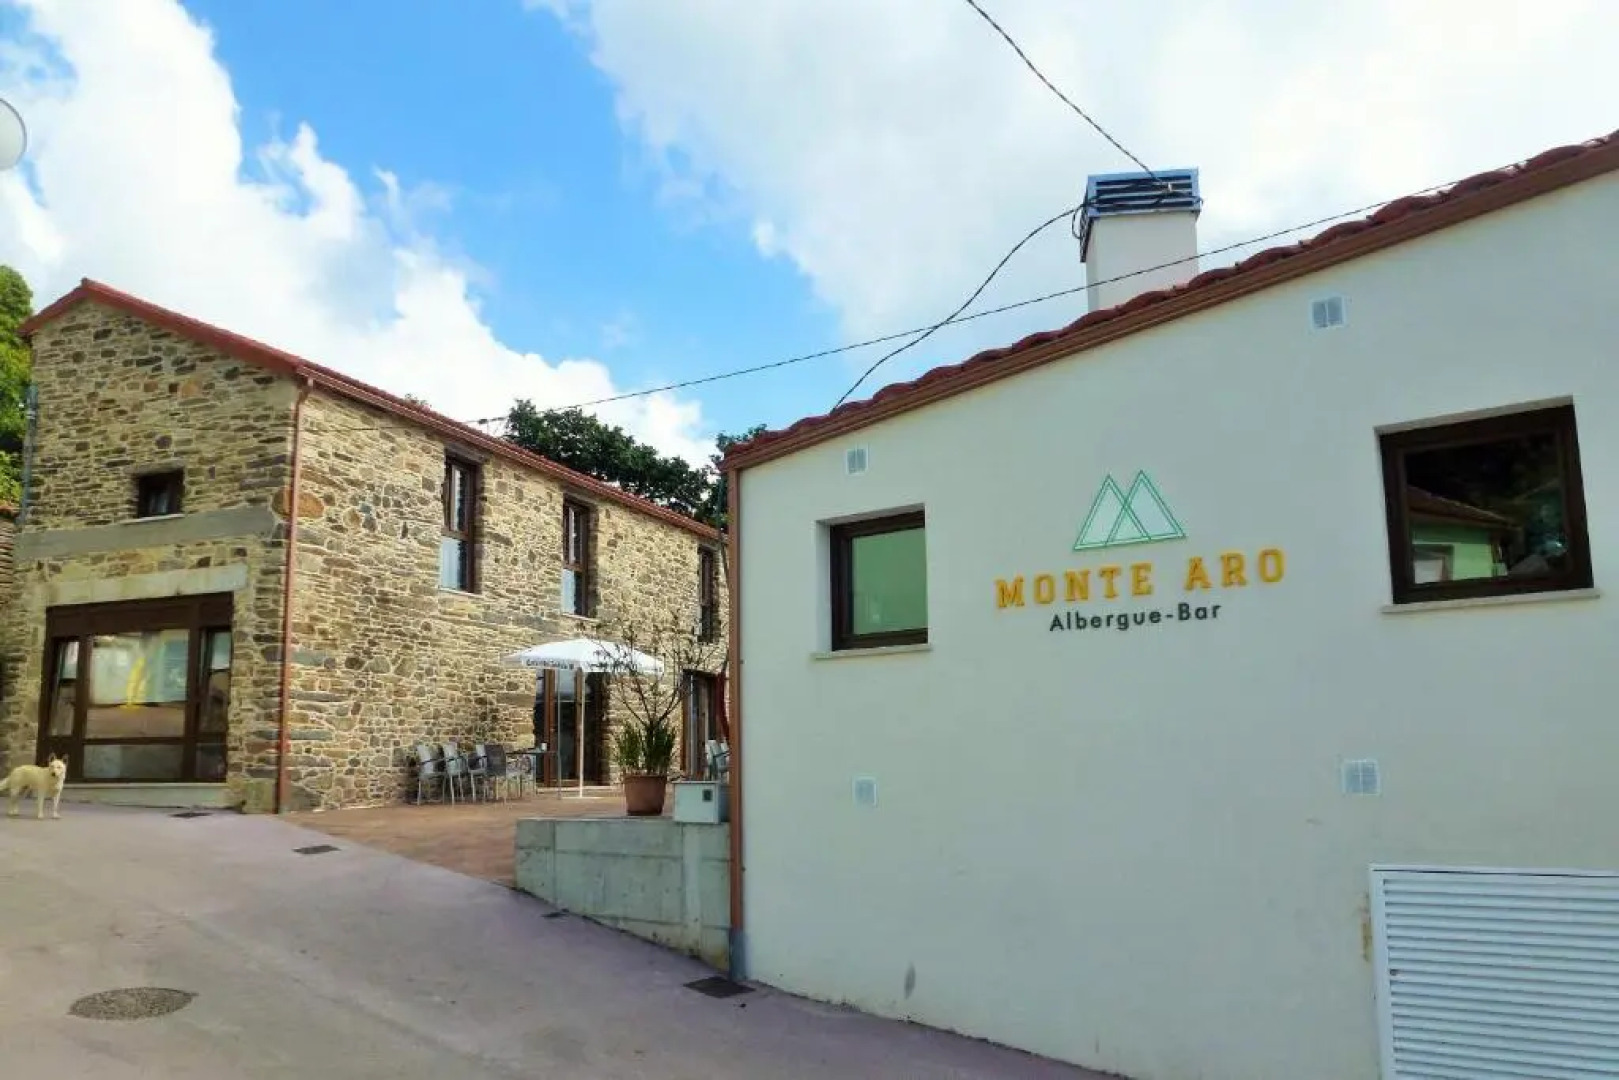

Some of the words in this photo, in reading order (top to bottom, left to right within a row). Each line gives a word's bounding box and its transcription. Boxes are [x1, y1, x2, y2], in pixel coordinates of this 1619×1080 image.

[995, 563, 1154, 608] MONTE
[1184, 548, 1285, 591] ARO
[1049, 603, 1222, 632] Albergue-Bar
